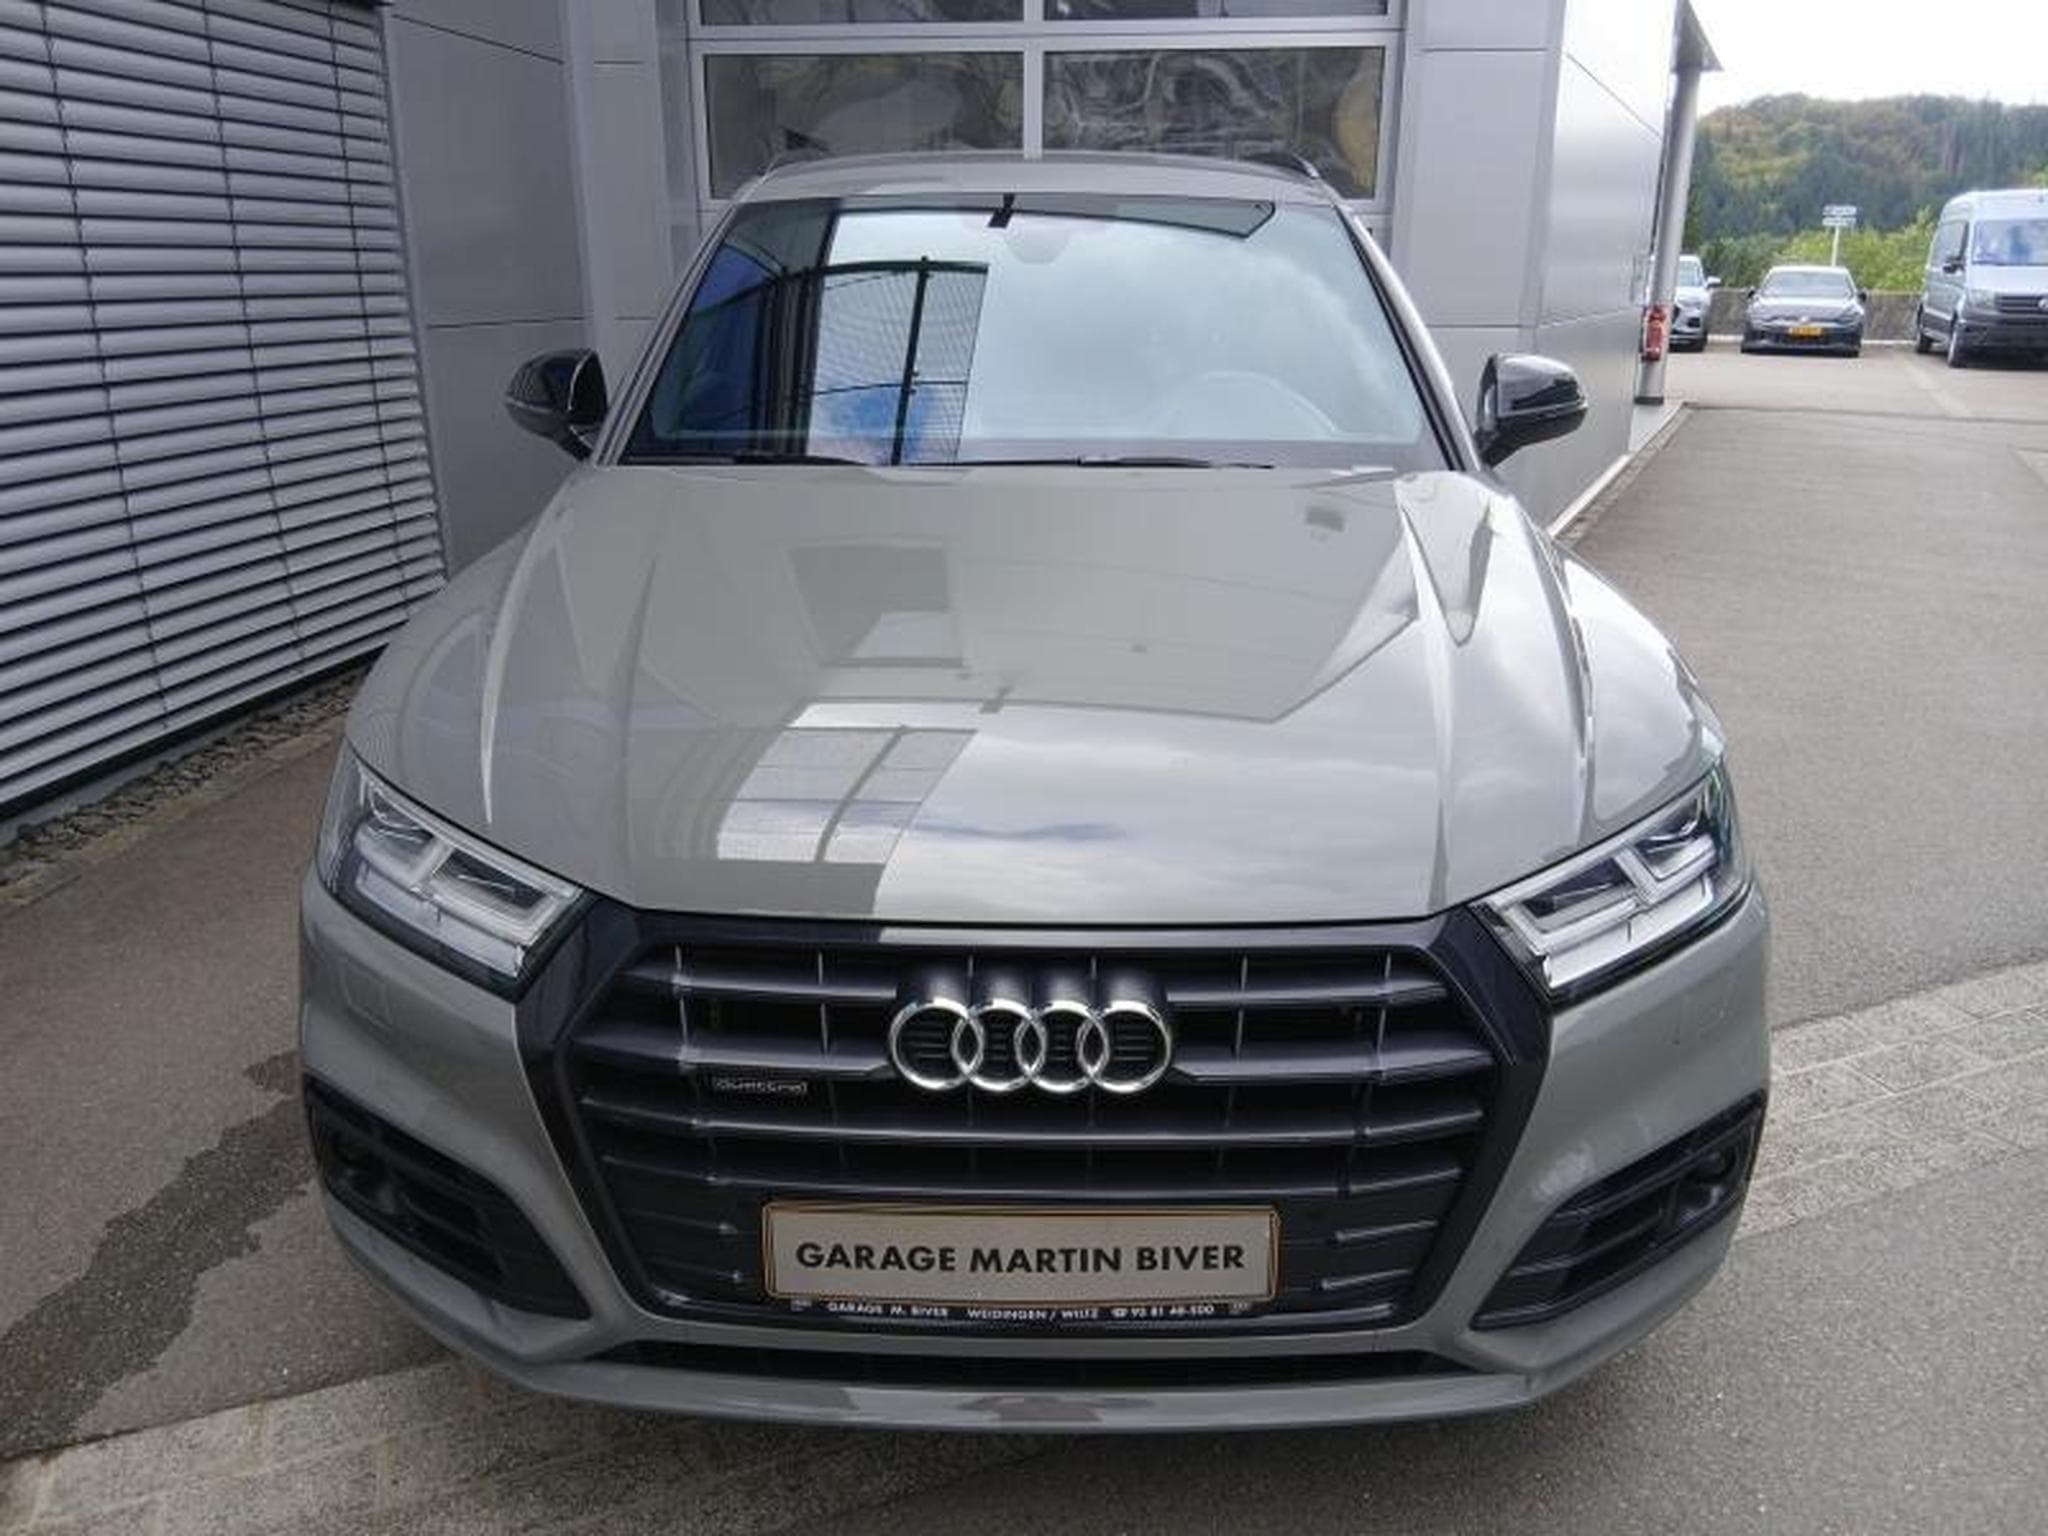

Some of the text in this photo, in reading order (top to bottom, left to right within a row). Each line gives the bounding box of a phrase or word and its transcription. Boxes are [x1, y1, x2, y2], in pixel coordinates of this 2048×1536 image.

[796, 1242, 1246, 1274] GARAGE MARTIN BIVER
